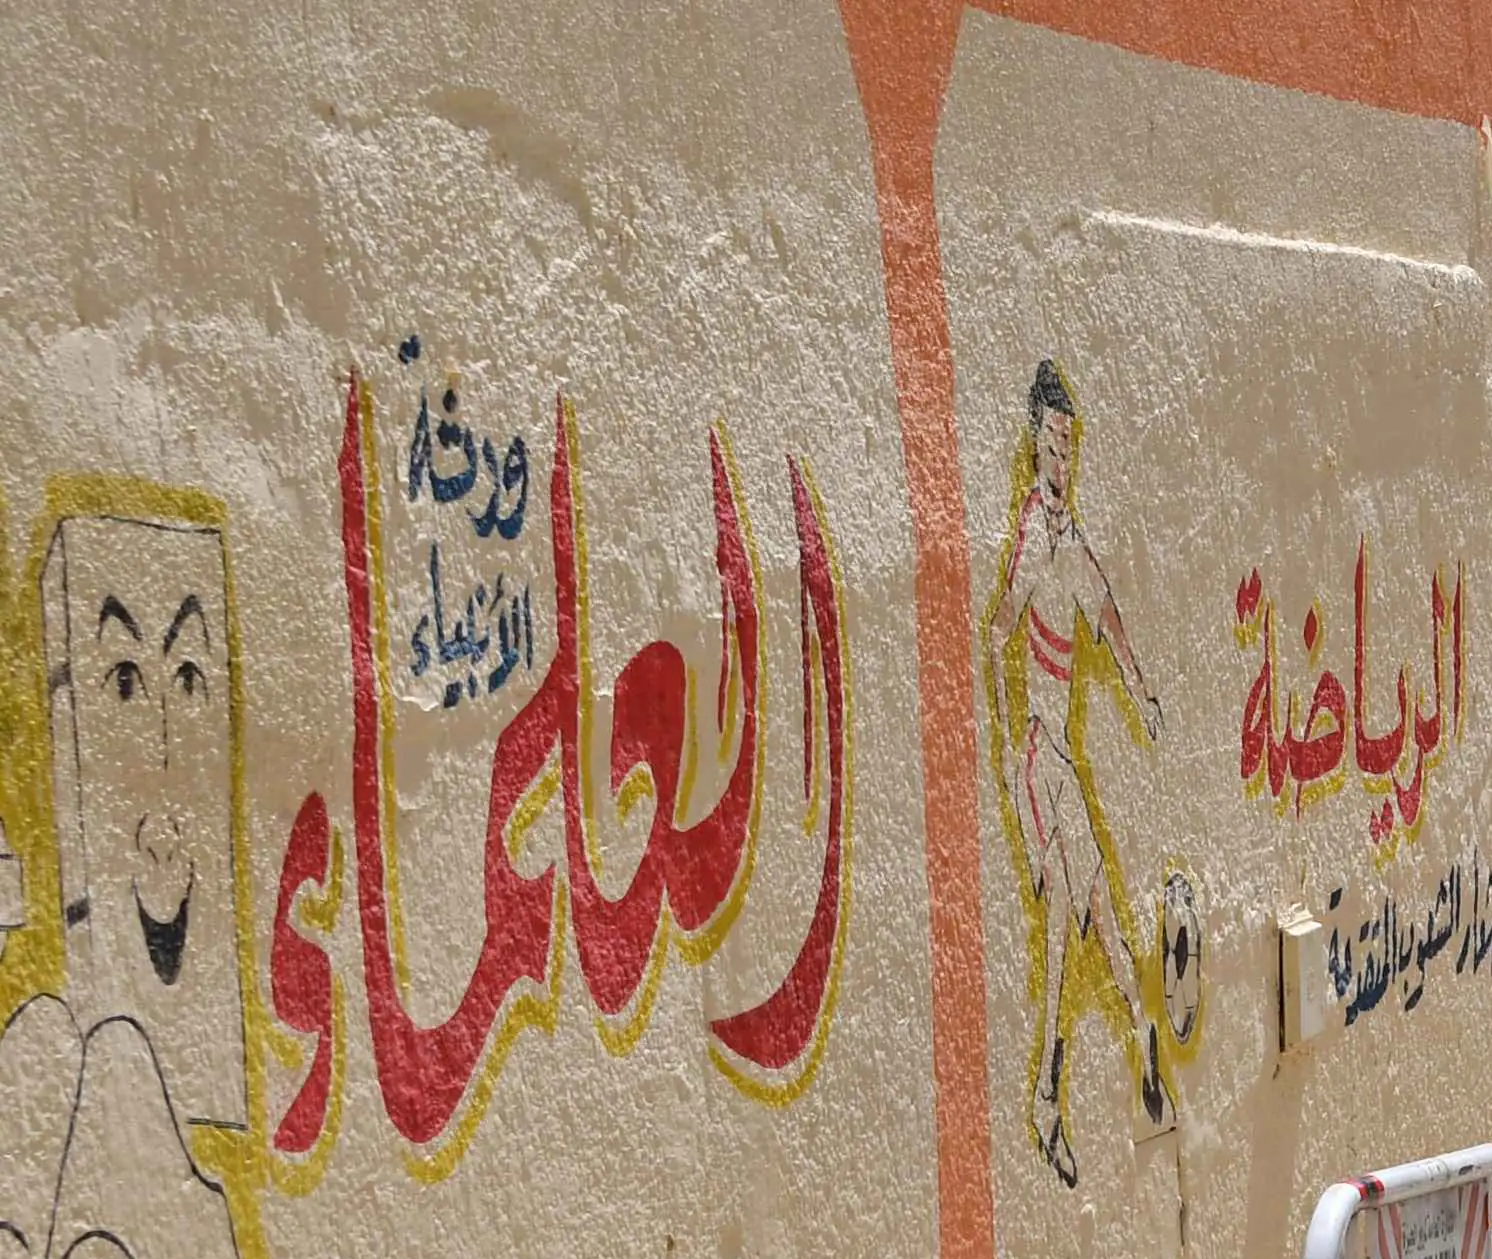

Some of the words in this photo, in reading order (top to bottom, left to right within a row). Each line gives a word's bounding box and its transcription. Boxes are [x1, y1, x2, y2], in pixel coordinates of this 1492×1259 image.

[399, 334, 530, 539] ورثة
[410, 546, 534, 707] الأنبياء
[1235, 532, 1464, 844] الرياضة
[270, 366, 850, 1160] العلماء
